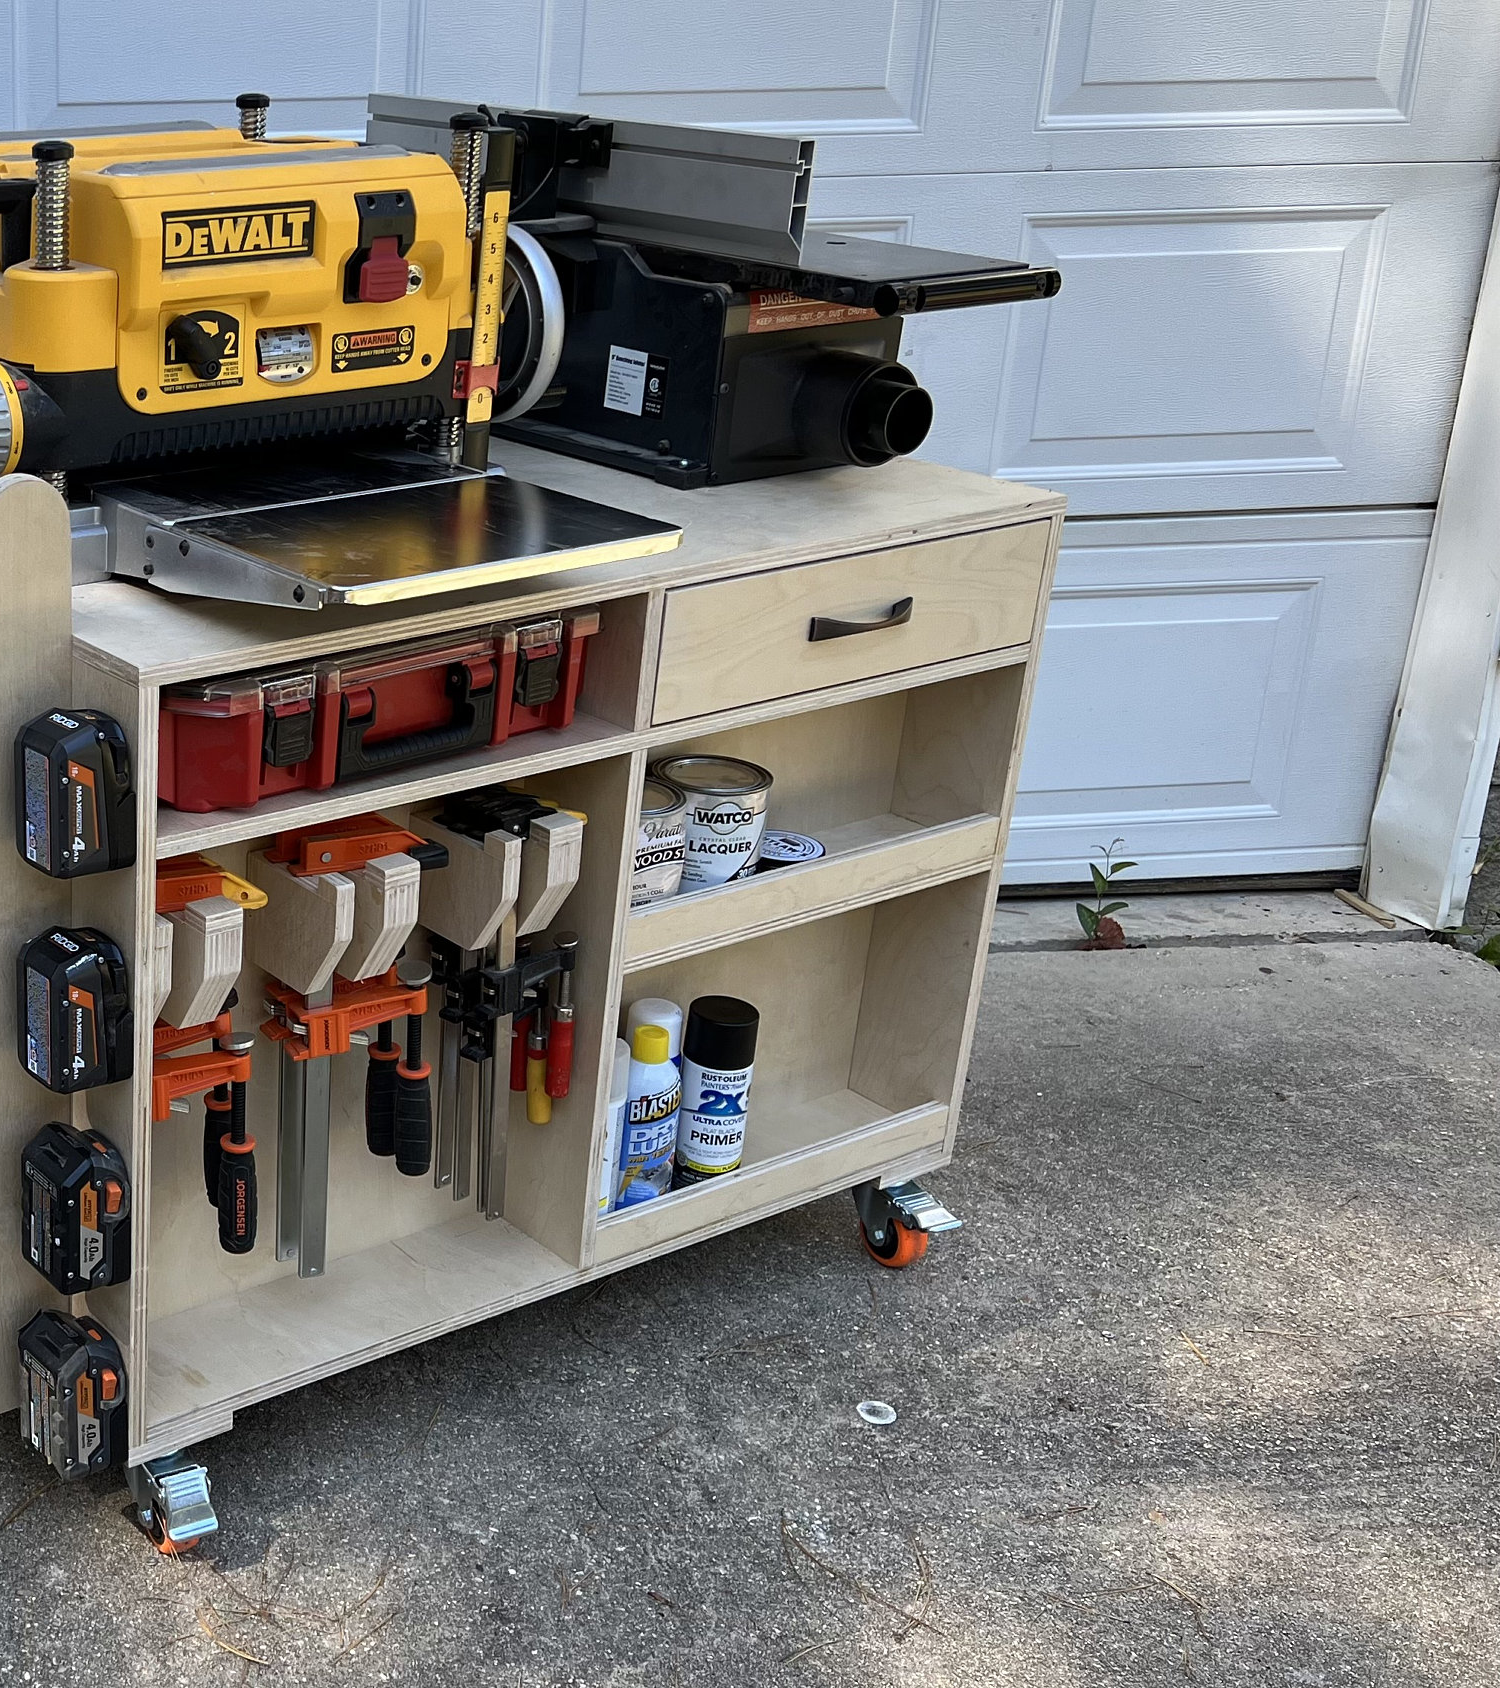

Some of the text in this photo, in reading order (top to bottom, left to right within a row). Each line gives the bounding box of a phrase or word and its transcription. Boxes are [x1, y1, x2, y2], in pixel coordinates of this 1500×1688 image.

[493, 212, 499, 223] 6
[165, 212, 310, 258] DEWALT
[490, 243, 497, 254] 5
[487, 273, 494, 285] 4
[485, 304, 491, 315] 3
[756, 317, 772, 325] KEEP
[776, 315, 797, 323] HANDS
[829, 309, 844, 317] DUST
[224, 331, 236, 355] 2
[360, 333, 396, 347] WARNING
[482, 333, 488, 344] 2
[167, 338, 176, 360] 1
[477, 392, 483, 403] 0
[49, 713, 79, 729] RIDGID
[697, 810, 752, 825] WATCO
[635, 841, 673, 855] PREMIUM
[688, 840, 752, 855] LACQUER
[737, 868, 747, 879] 30
[50, 932, 80, 952] RIDGID
[701, 1072, 747, 1083] RUST-OLEUM
[698, 1090, 744, 1116] 2X
[692, 1114, 722, 1126] ULTRA
[690, 1130, 743, 1146] PRIMER
[717, 1127, 735, 1135] BLACK
[236, 1178, 245, 1236] JORGENSEN
[88, 1237, 99, 1262] 4.0Ah
[86, 1423, 96, 1448] 4.0Ah
